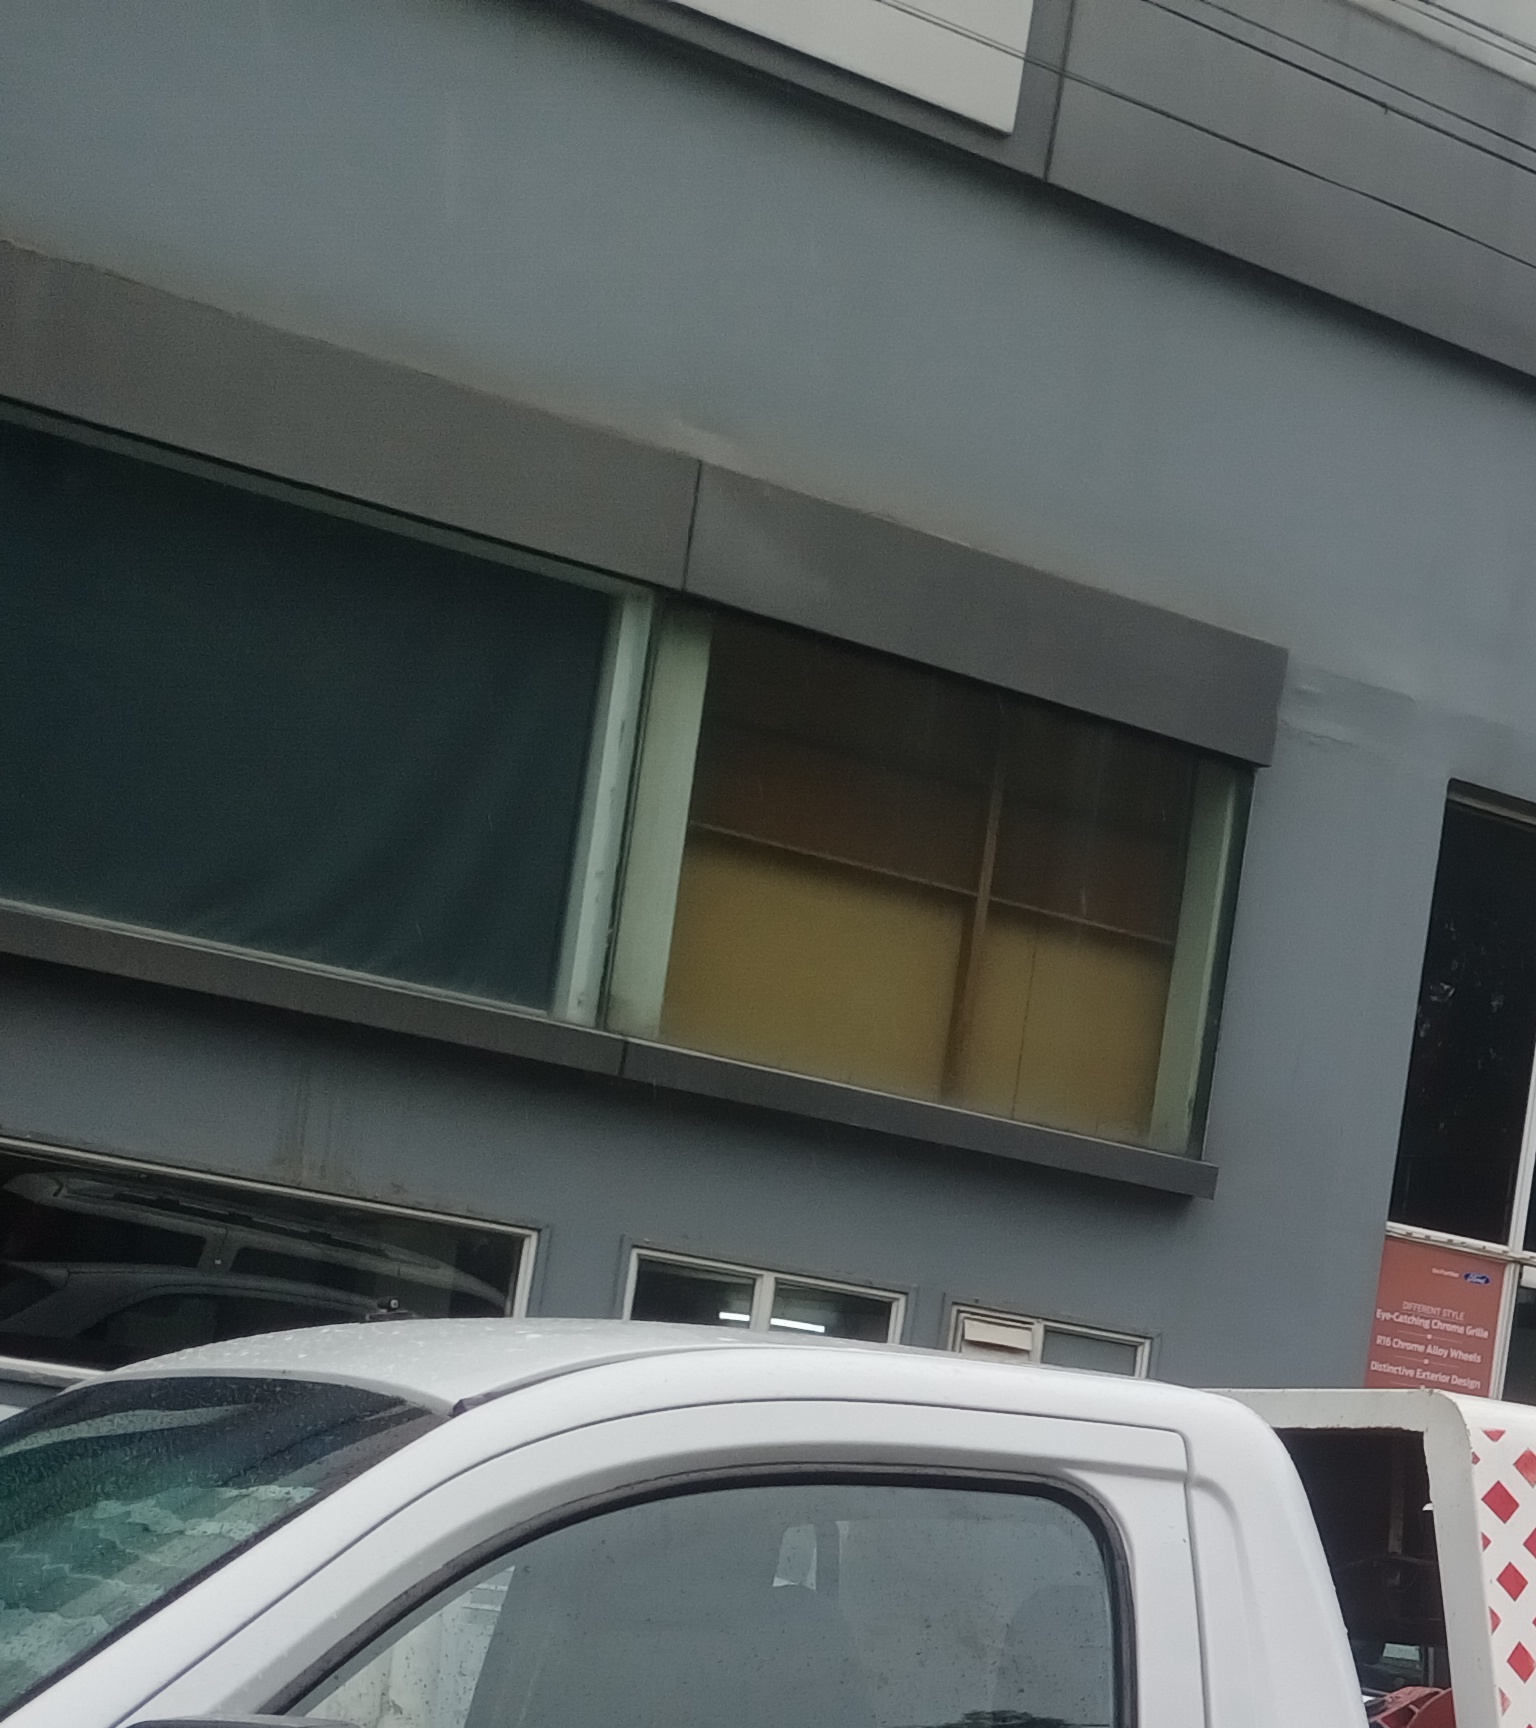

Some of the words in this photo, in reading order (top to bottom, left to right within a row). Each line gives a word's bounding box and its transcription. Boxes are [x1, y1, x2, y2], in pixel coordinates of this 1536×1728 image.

[1376, 1308, 1430, 1329] Eye-Catching
[1431, 1319, 1464, 1335] Chrome
[1465, 1325, 1489, 1339] Grille
[1402, 1301, 1441, 1316] DIFFERENT
[1442, 1308, 1465, 1321] STYLE
[1392, 1338, 1425, 1354] Chrome
[1426, 1344, 1449, 1359] Alloy
[1449, 1348, 1482, 1363] Wheels
[1370, 1360, 1415, 1378] Distinctive
[1415, 1368, 1450, 1384] Exterior
[1450, 1375, 1481, 1390] Design
